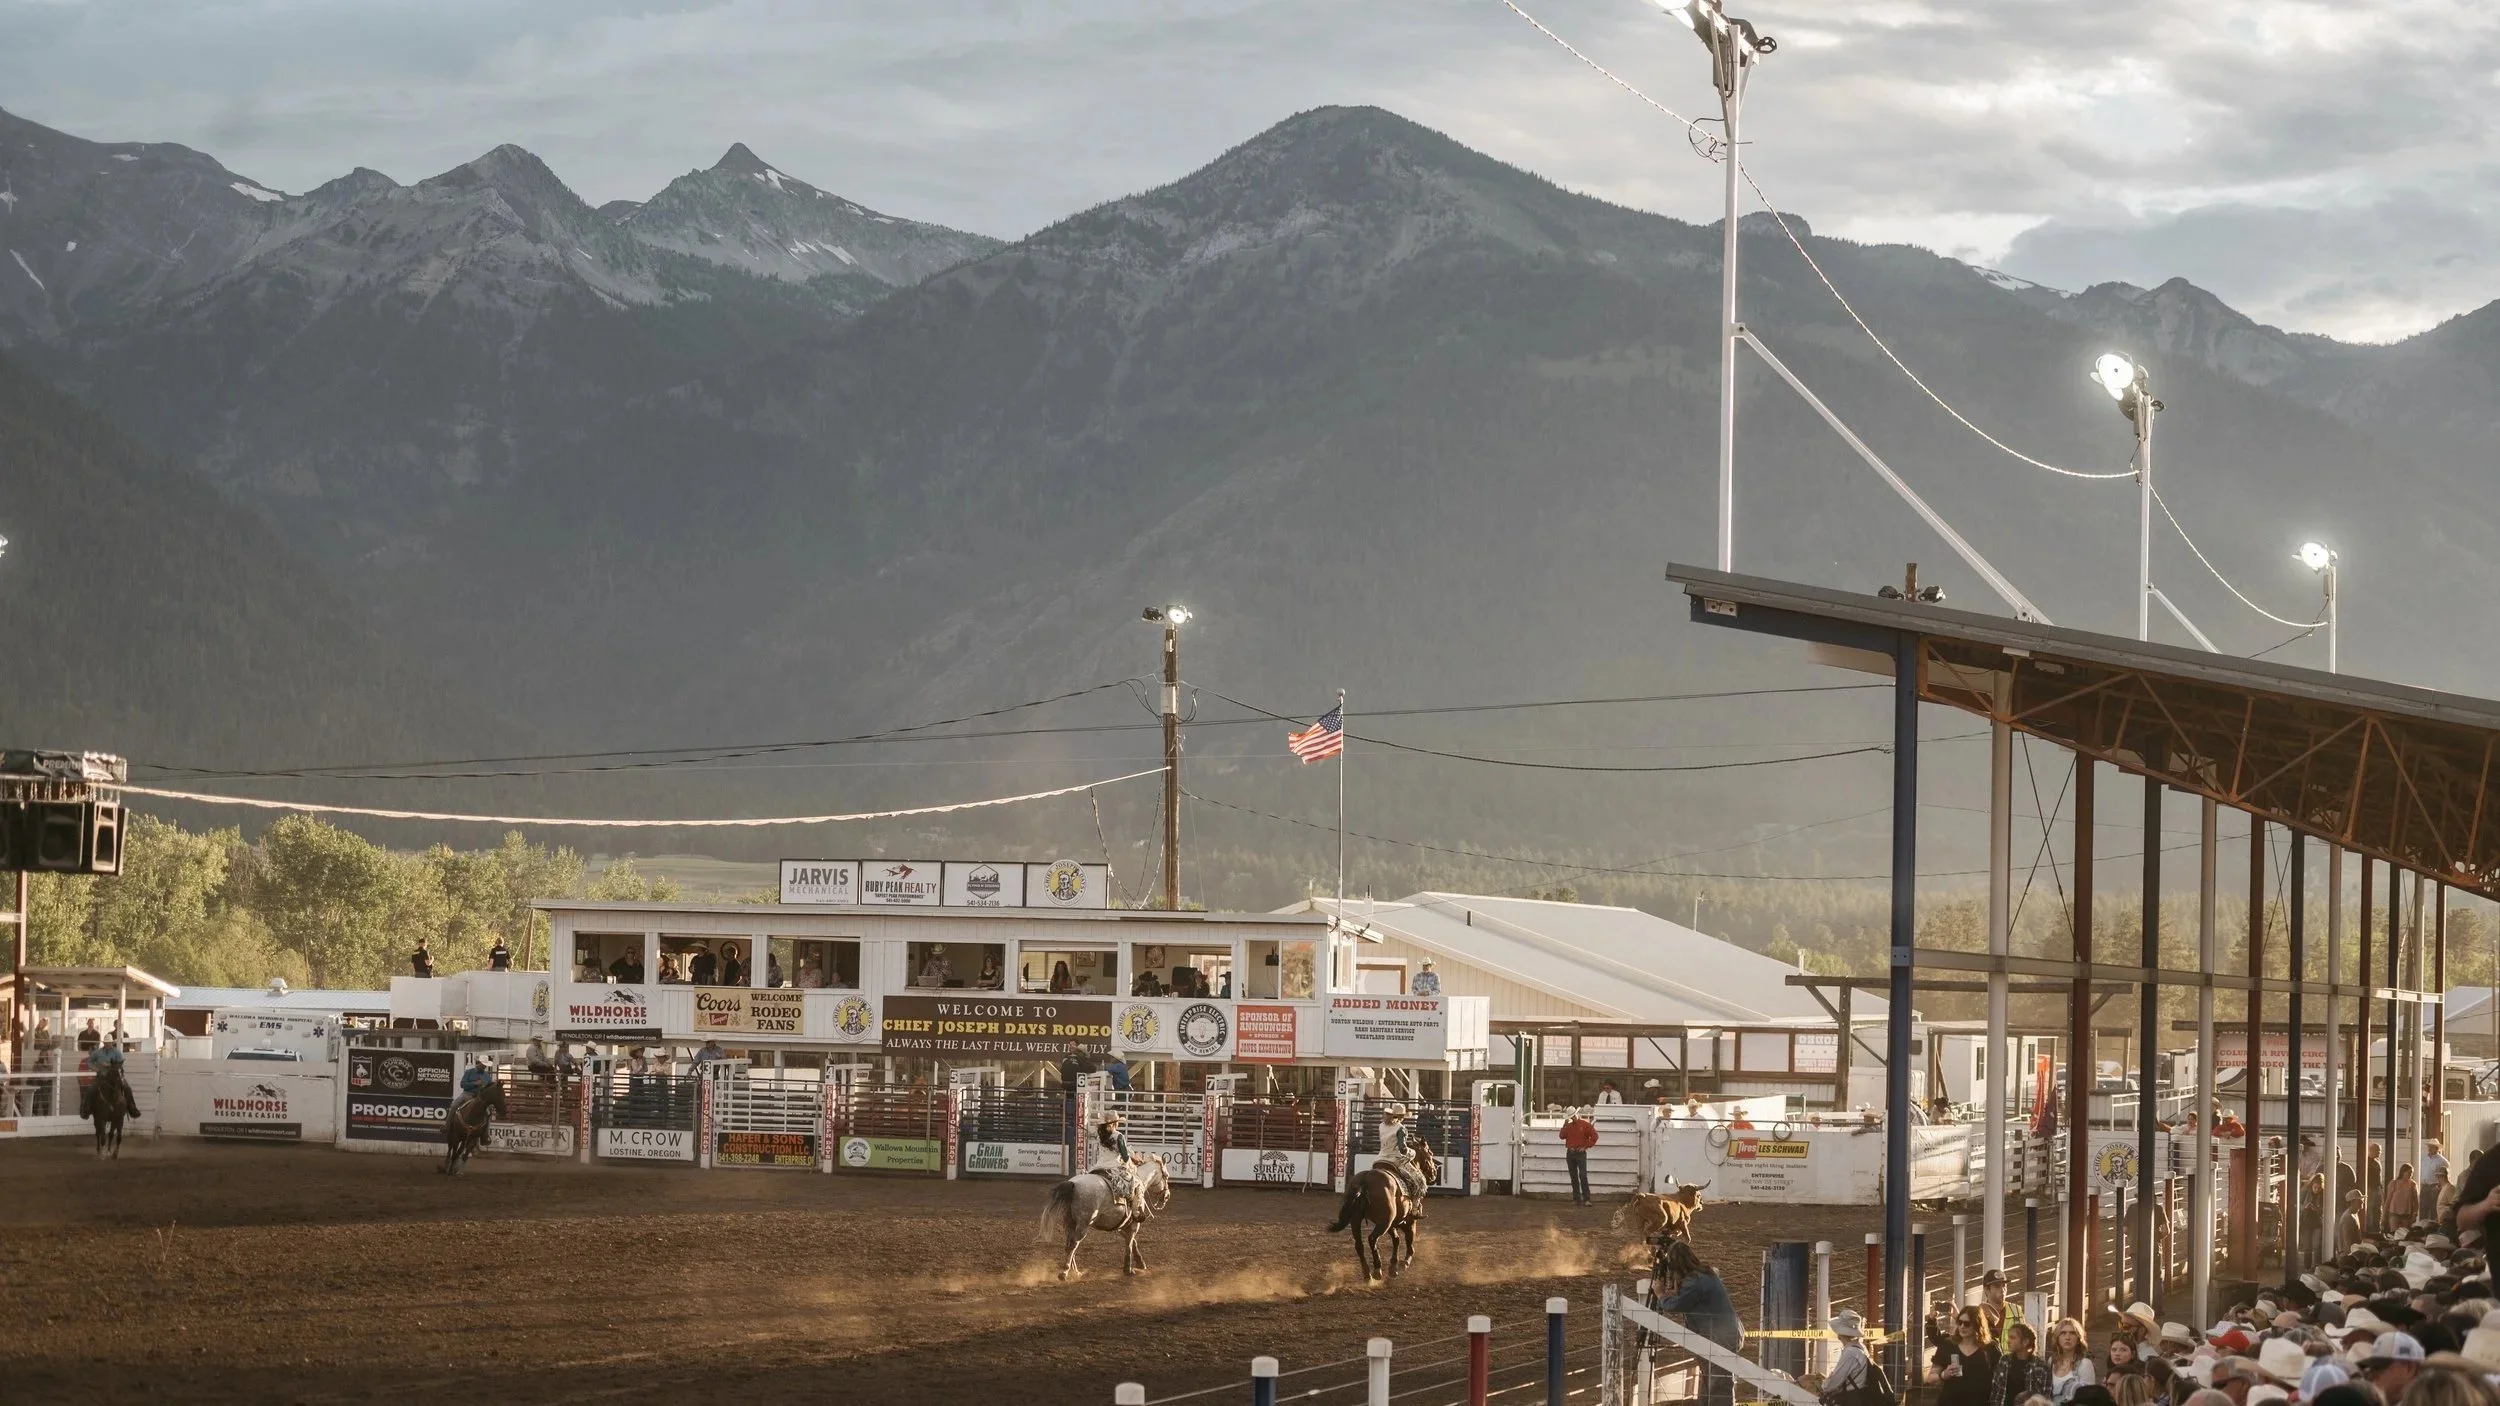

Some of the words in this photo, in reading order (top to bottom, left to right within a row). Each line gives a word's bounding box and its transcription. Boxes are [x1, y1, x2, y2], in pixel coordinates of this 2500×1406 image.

[789, 868, 849, 885] JARVIS
[789, 886, 849, 895] MECHANICAL
[865, 880, 883, 892] RUBY
[885, 881, 903, 893] PEAK
[904, 882, 937, 894] REALTY
[696, 992, 742, 1012] Coors
[751, 993, 802, 1002] WELCOME
[937, 1004, 1024, 1017] WELCOME
[1033, 1006, 1057, 1018] TO
[1332, 999, 1381, 1009] ADDED
[1386, 1000, 1439, 1011] MONEY
[570, 1005, 647, 1018] WILDHORSE
[751, 1007, 802, 1018] RODEO
[1240, 1012, 1280, 1022] SPONSOR
[1282, 1013, 1293, 1022] OF
[756, 1020, 795, 1031] FANS
[1180, 1005, 1207, 1034] ENTERPRISE
[882, 1019, 932, 1032] CHIEF
[937, 1021, 999, 1035] JOSEPH
[1005, 1022, 1047, 1035] DAYS
[1052, 1024, 1112, 1037] RODEO
[1240, 1022, 1293, 1032] ANNOUNCER
[886, 1038, 932, 1049] ALWAYS
[934, 1039, 959, 1050] THE
[961, 1040, 989, 1051] LAST
[993, 1041, 1022, 1052] FULL
[1026, 1042, 1058, 1053] WEEK
[1084, 1043, 1107, 1054] ULY
[466, 1053, 473, 1066] 1
[584, 1057, 591, 1068] 2
[704, 1062, 711, 1074] 3
[827, 1066, 834, 1078] 4
[951, 1070, 958, 1082] 5
[1078, 1075, 1085, 1087] 6
[1207, 1077, 1214, 1089] 7
[1339, 1081, 1346, 1093] 8
[214, 1098, 287, 1112] WILDHORSE
[352, 1103, 447, 1119] PRORODEO
[489, 1128, 526, 1139] TRIPLE
[610, 1130, 626, 1145] M.
[632, 1132, 682, 1147] CROW
[728, 1134, 763, 1143] HAFER
[763, 1135, 769, 1144] &
[772, 1134, 804, 1144] SONS
[507, 1139, 544, 1149] RANCH
[723, 1143, 793, 1154] CONSTRUCTION
[795, 1145, 809, 1155] LLC
[874, 1144, 904, 1152] Wallowa
[905, 1145, 938, 1153] Mountain
[977, 1143, 1004, 1157] GRAIN
[1738, 1141, 1757, 1153] Tires
[1758, 1145, 1771, 1153] LES
[1772, 1145, 1805, 1154] SCHWAB
[647, 1149, 680, 1157] OREGON
[887, 1156, 924, 1165] Properties
[968, 1154, 1009, 1170] GROWERS
[1253, 1164, 1295, 1174] SURFACE
[1255, 1173, 1293, 1182] FAMILY
